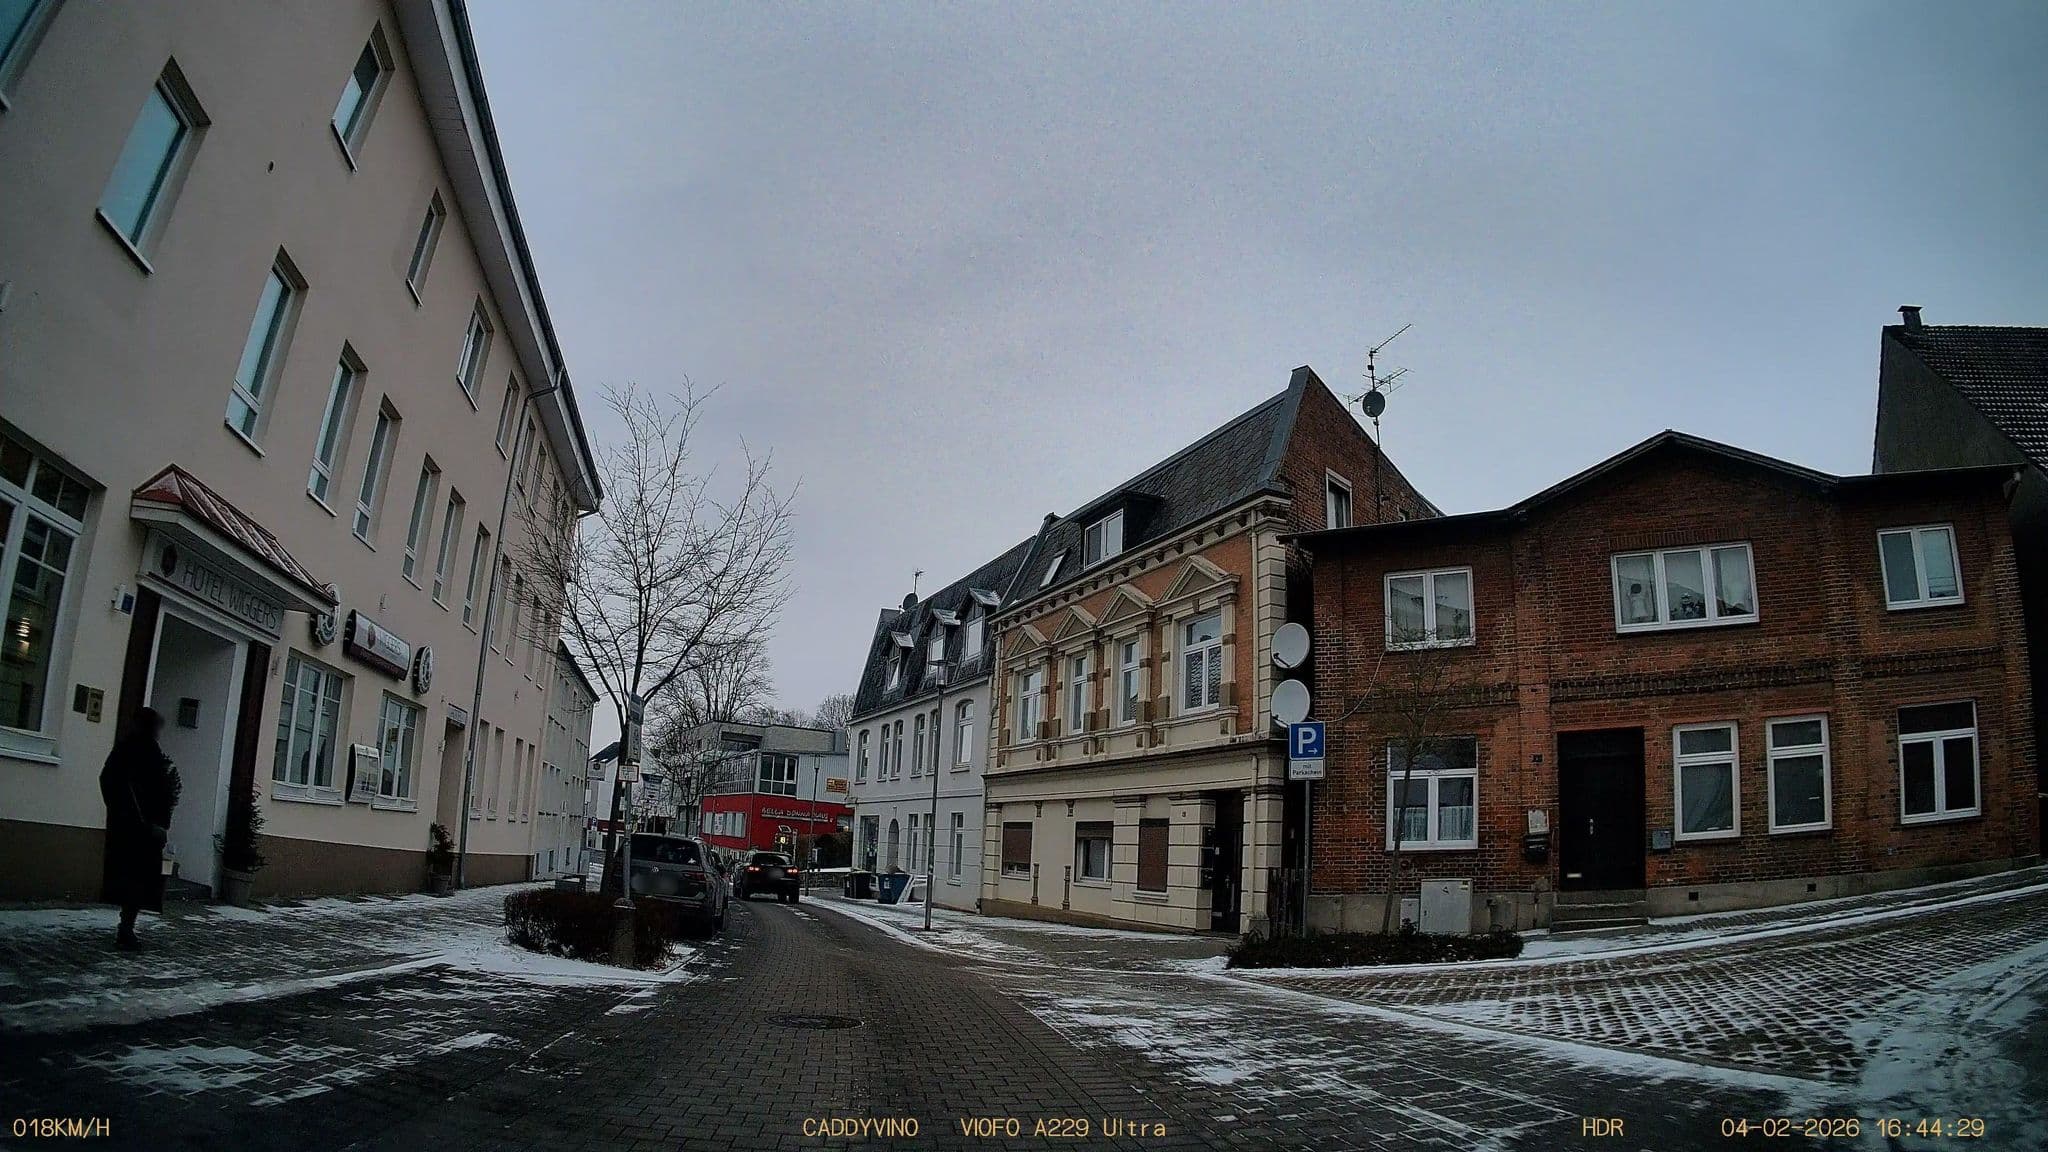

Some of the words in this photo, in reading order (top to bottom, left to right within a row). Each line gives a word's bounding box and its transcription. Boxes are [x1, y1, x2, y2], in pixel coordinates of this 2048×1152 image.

[183, 562, 224, 604] HOTEL
[229, 583, 278, 629] WIGGERS
[1299, 727, 1316, 754] P
